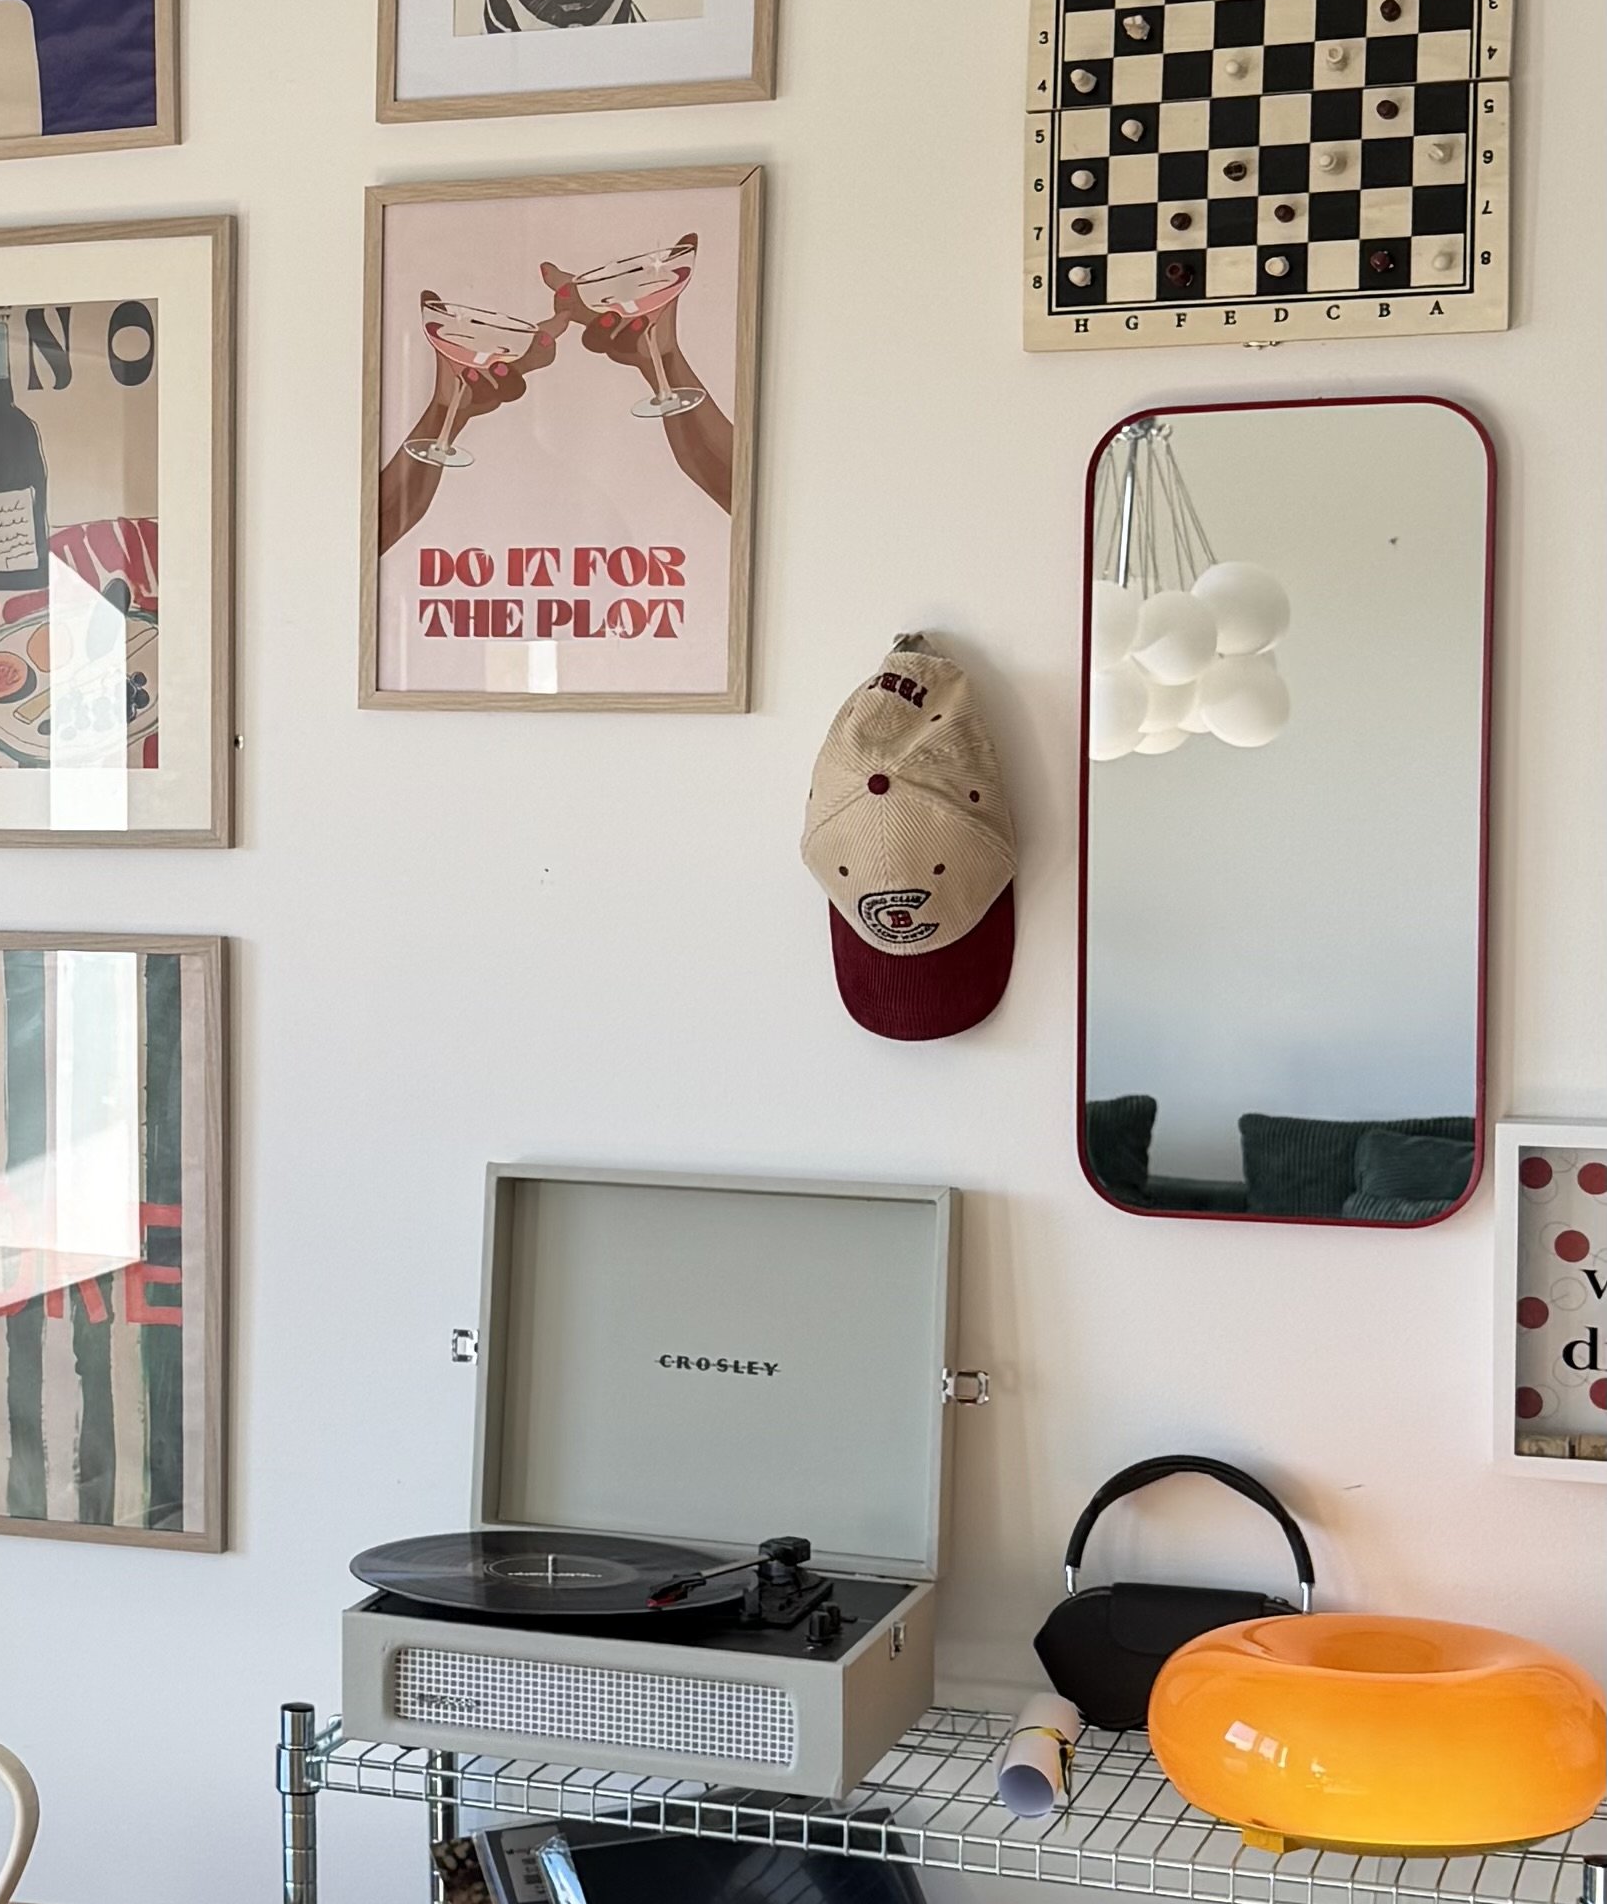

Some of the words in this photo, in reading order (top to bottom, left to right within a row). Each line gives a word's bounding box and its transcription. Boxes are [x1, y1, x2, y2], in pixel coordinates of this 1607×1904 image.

[1038, 30, 1049, 45] 3
[1037, 79, 1047, 93] 4
[1035, 129, 1045, 144] 5
[1033, 178, 1045, 193] 6
[1033, 226, 1044, 241] 7
[1032, 275, 1043, 290] 8
[1074, 318, 1090, 334] H
[1125, 315, 1139, 331] G
[1175, 312, 1187, 328] F
[1223, 310, 1237, 326] E
[1273, 307, 1289, 323] D
[1325, 304, 1341, 321] C
[1378, 302, 1391, 318] B
[1429, 300, 1445, 316] A
[419, 547, 495, 587] DO
[507, 547, 561, 587] IT
[573, 546, 686, 587] FOR
[419, 599, 523, 638] THE
[537, 598, 685, 639] PLOT
[657, 1353, 779, 1377] CROSLEY
